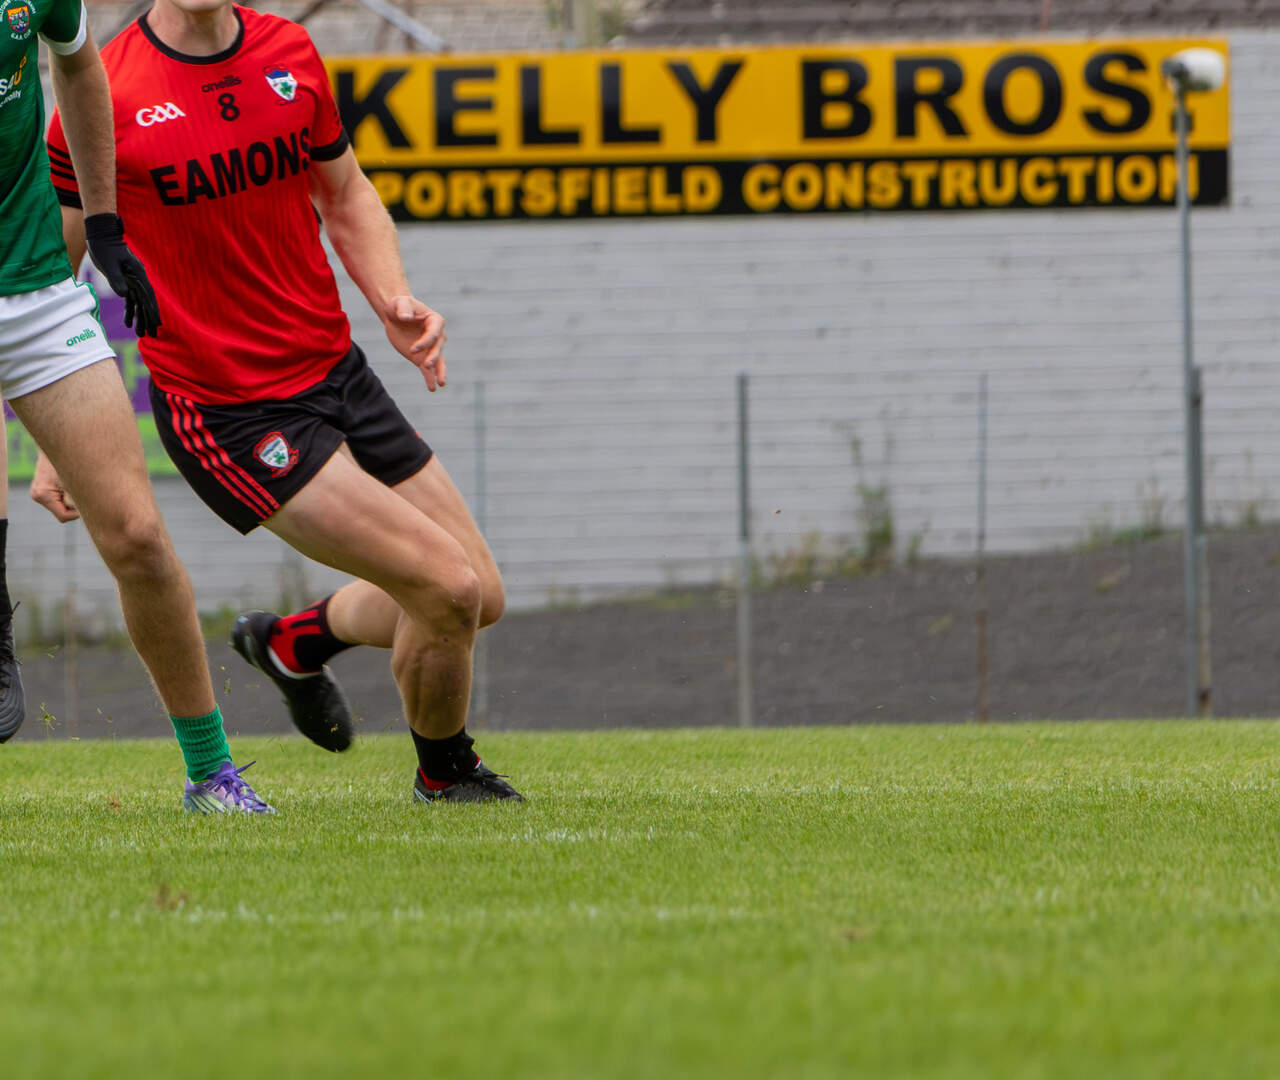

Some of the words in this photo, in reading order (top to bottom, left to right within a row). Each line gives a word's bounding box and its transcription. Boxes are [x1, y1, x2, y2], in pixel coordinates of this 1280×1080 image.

[218, 92, 240, 121] 8
[337, 60, 745, 151] KELLY
[370, 165, 722, 217] PORTSFIELD
[742, 154, 1200, 211] CONSTRUCTION
